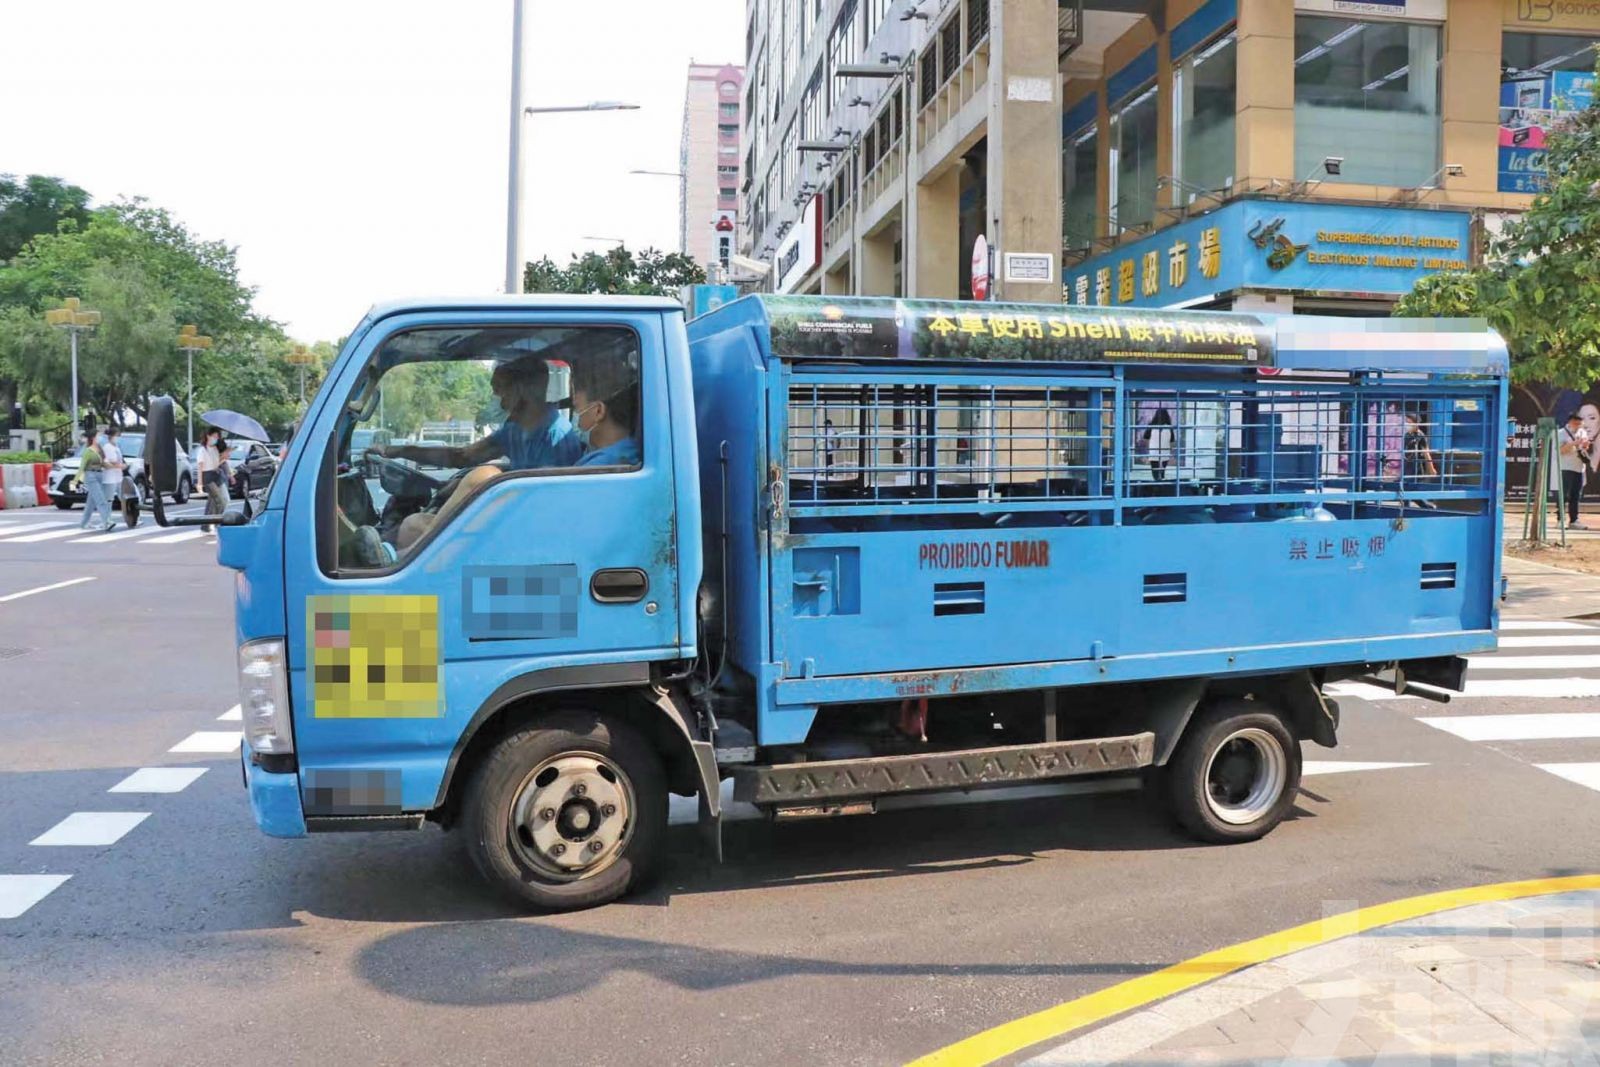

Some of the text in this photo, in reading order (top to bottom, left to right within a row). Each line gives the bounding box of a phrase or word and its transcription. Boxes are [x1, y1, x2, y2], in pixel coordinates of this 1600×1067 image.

[927, 309, 1044, 339] 本車使用
[1048, 314, 1122, 340] Shell
[919, 540, 1049, 570] PROIBIDO FUMAR
